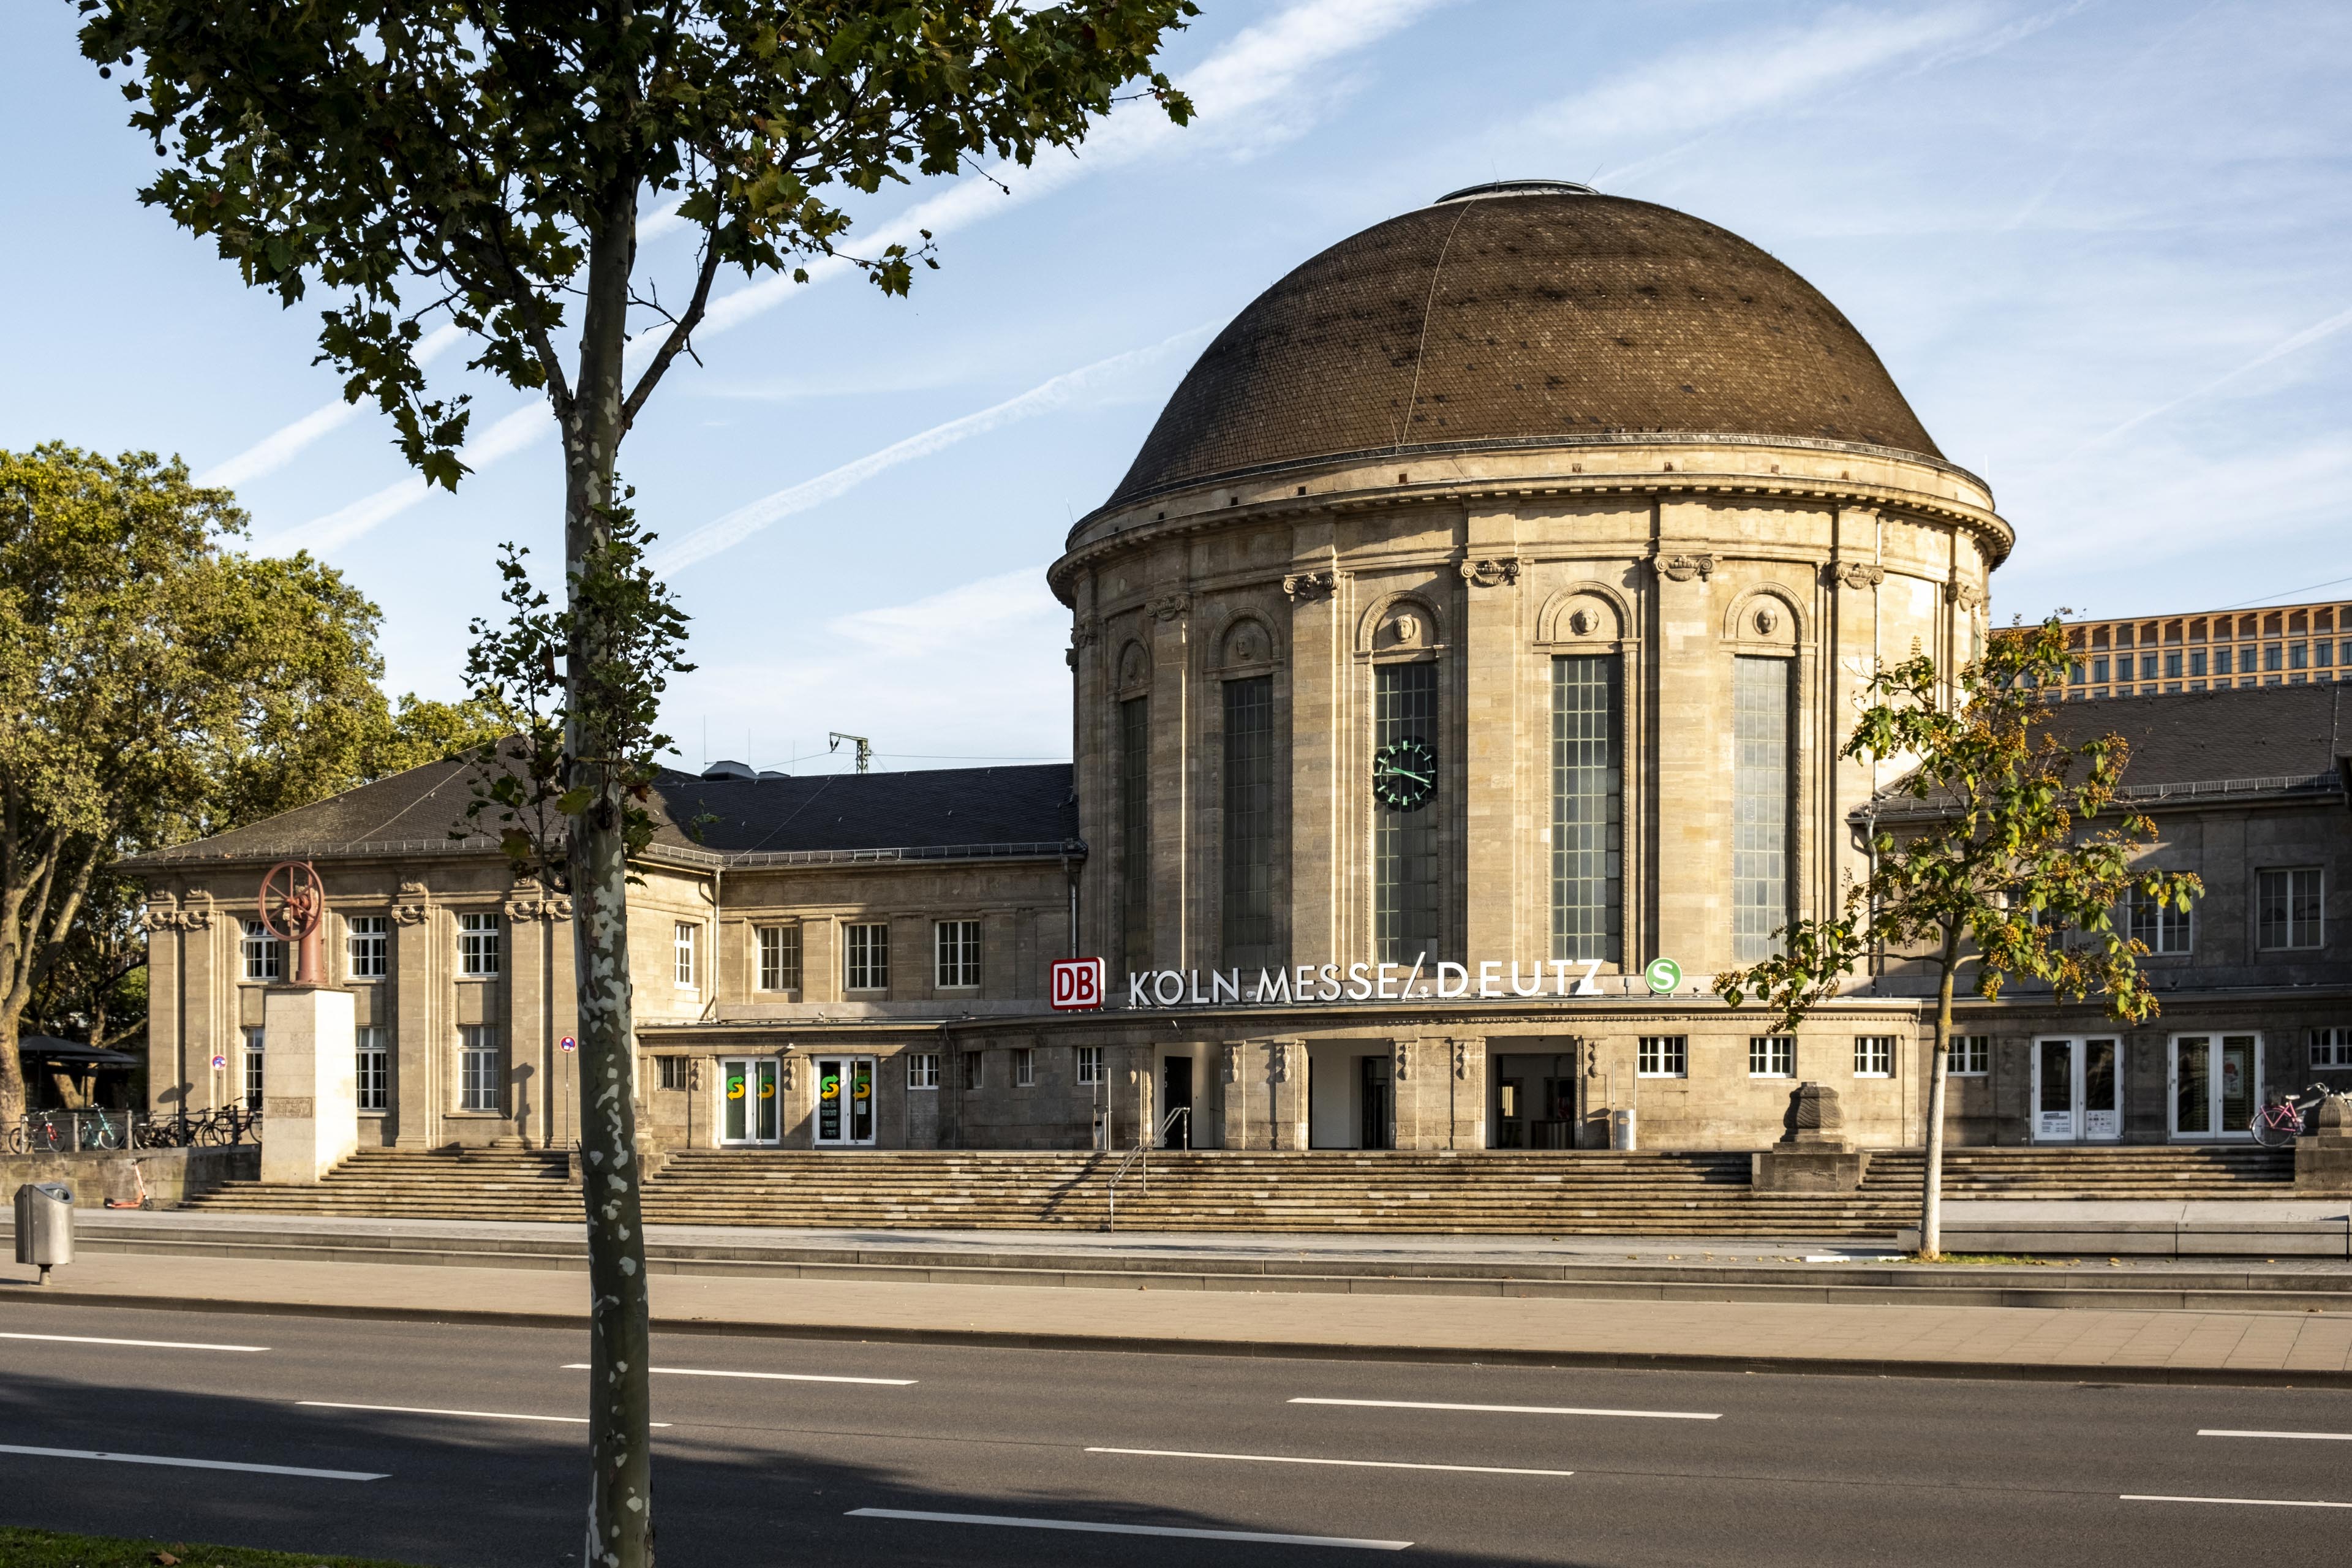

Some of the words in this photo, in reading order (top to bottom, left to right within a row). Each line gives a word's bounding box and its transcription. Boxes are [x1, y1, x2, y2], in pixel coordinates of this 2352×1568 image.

[1057, 966, 1094, 1001] DB
[1130, 968, 1240, 1005] KÖLN
[1653, 962, 1675, 990] S
